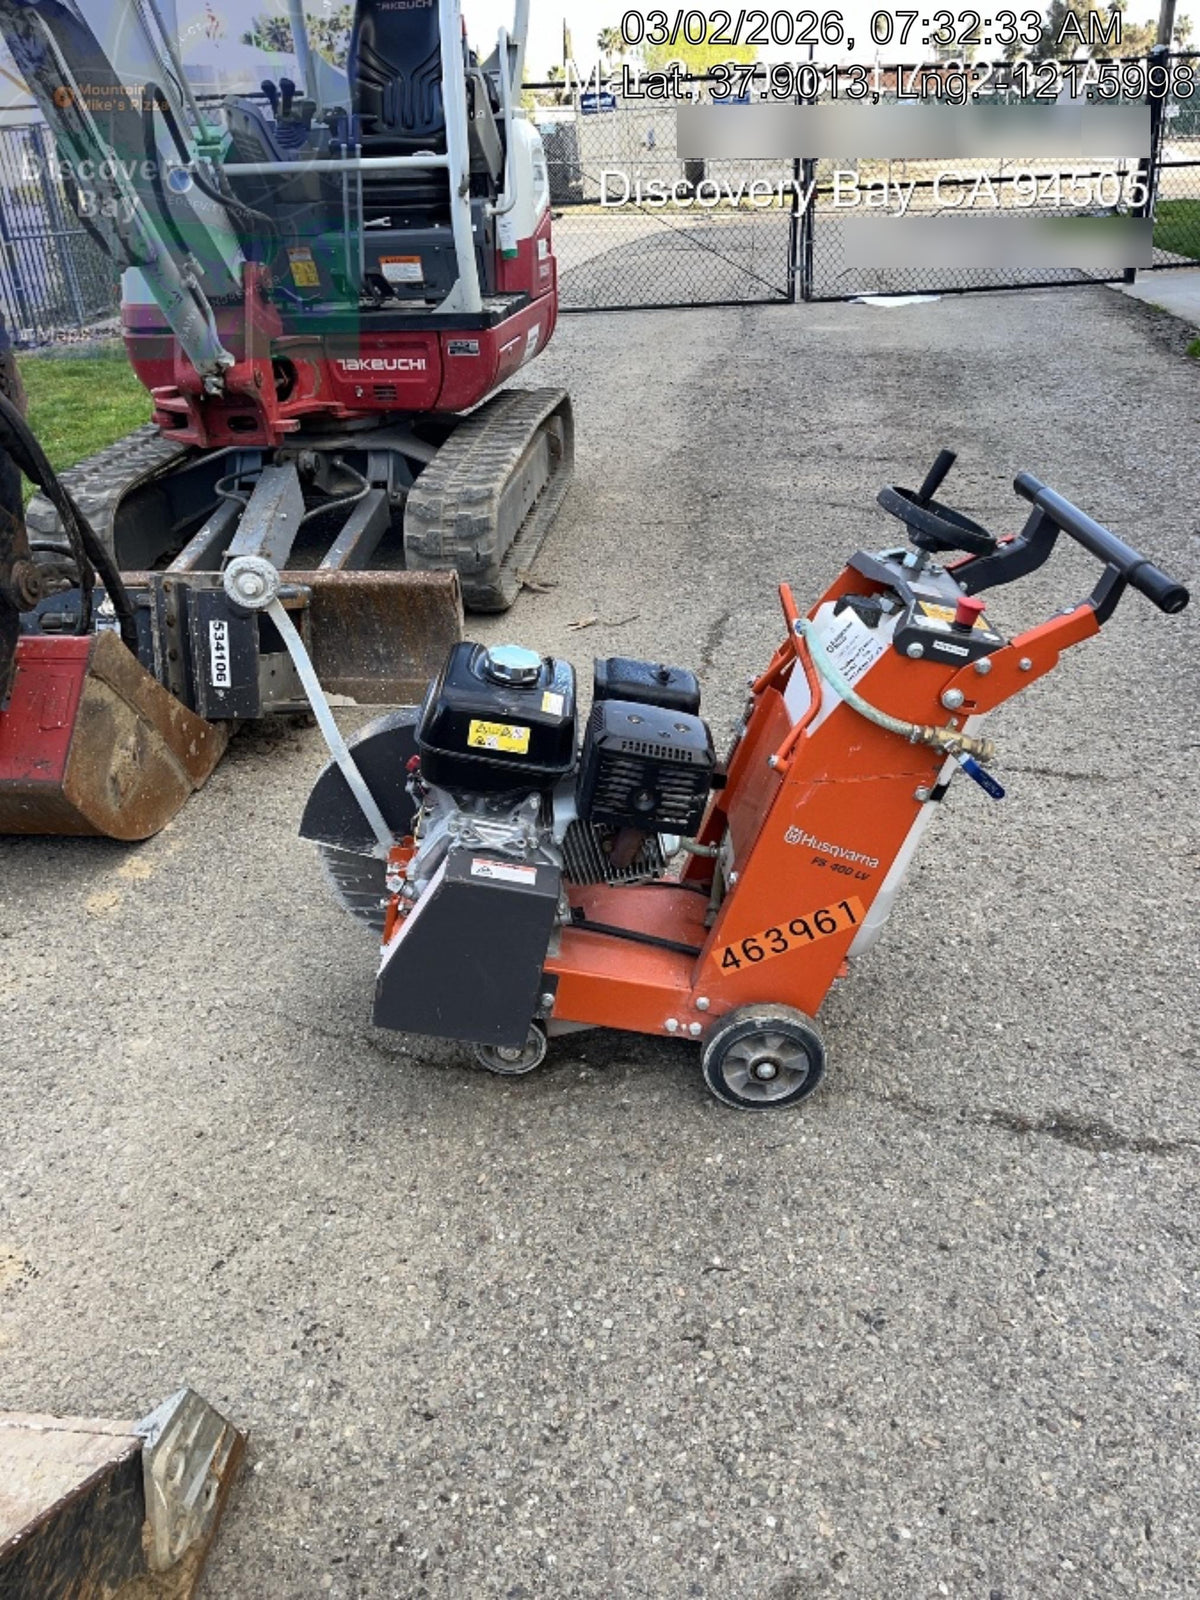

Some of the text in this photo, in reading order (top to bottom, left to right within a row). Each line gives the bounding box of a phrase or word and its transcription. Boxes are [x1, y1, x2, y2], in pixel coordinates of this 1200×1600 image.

[337, 357, 426, 371] TAKEUCHI
[212, 621, 227, 682] 534106
[801, 833, 879, 869] Husqvarna
[811, 856, 871, 881] FS 400 LV
[721, 900, 857, 969] 463961
